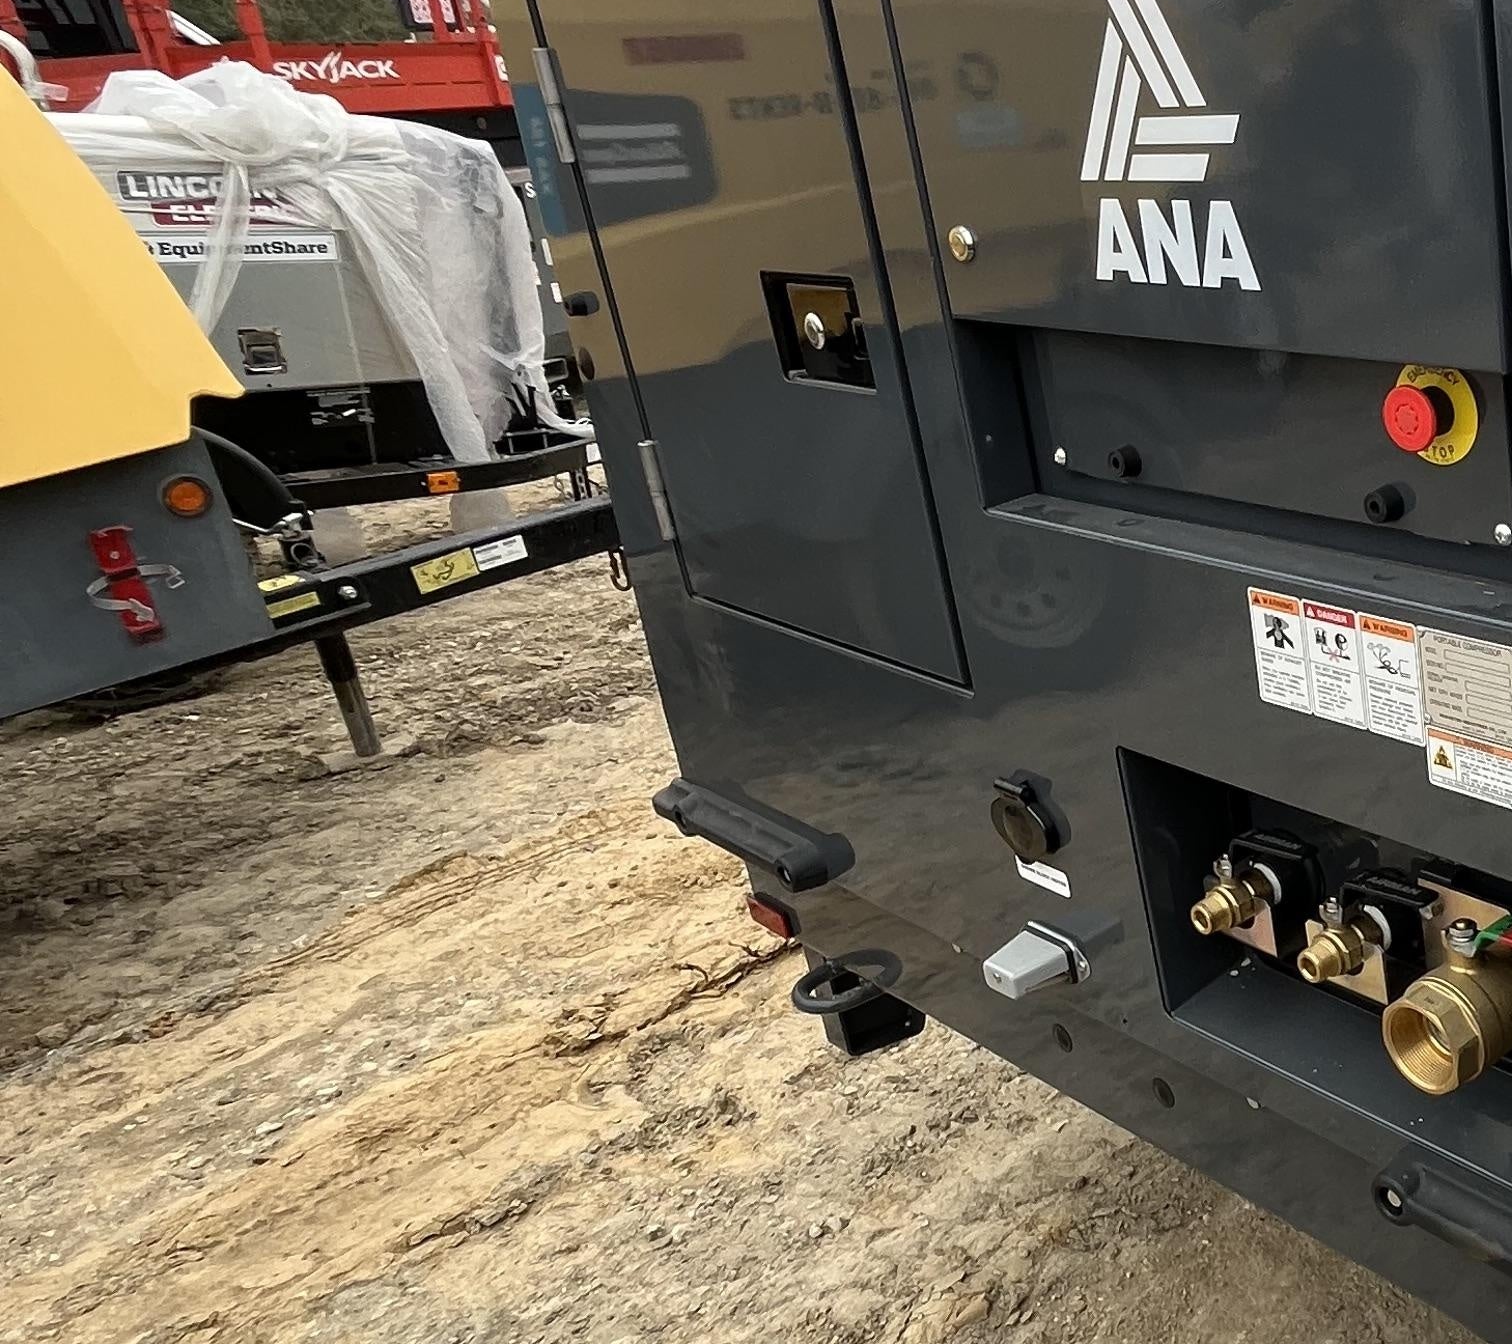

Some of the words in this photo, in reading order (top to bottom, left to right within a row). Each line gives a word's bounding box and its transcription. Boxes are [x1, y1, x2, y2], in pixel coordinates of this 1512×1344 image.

[273, 51, 400, 84] SKYJACK
[126, 174, 278, 199] LINCON
[158, 241, 329, 258] EquientShare
[1096, 198, 1262, 291] ANA
